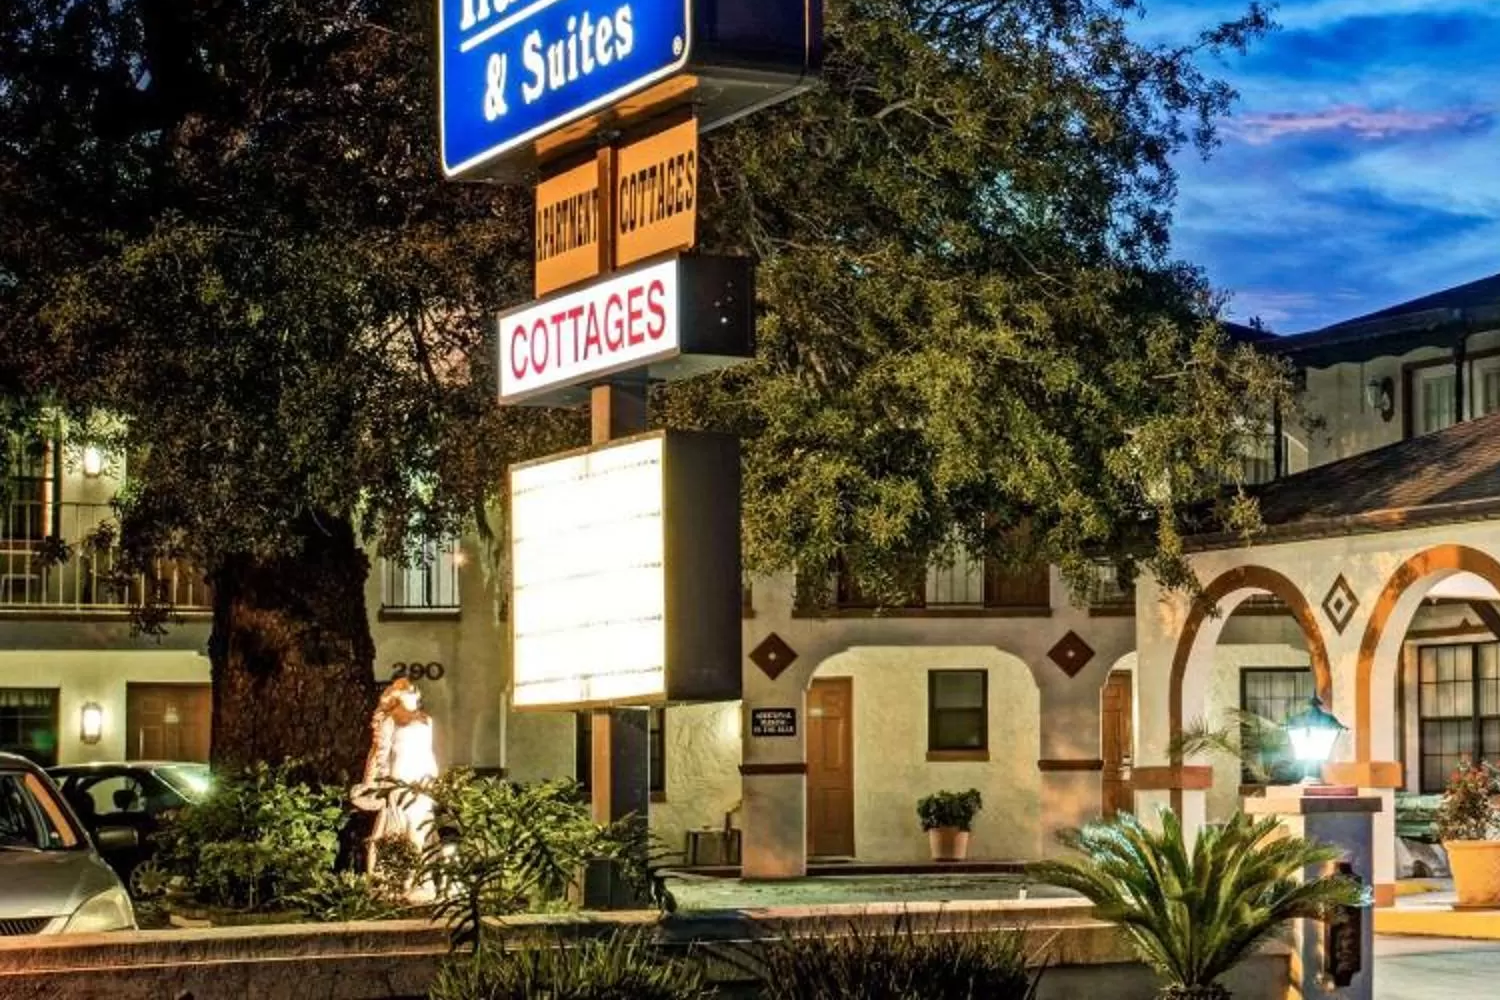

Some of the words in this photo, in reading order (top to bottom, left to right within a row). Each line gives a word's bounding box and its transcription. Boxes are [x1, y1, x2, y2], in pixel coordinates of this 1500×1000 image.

[484, 52, 508, 120] &
[521, 4, 635, 104] Suites
[619, 150, 695, 235] COTTAGES
[510, 279, 666, 380] COTTAGES
[392, 661, 445, 681] 290
